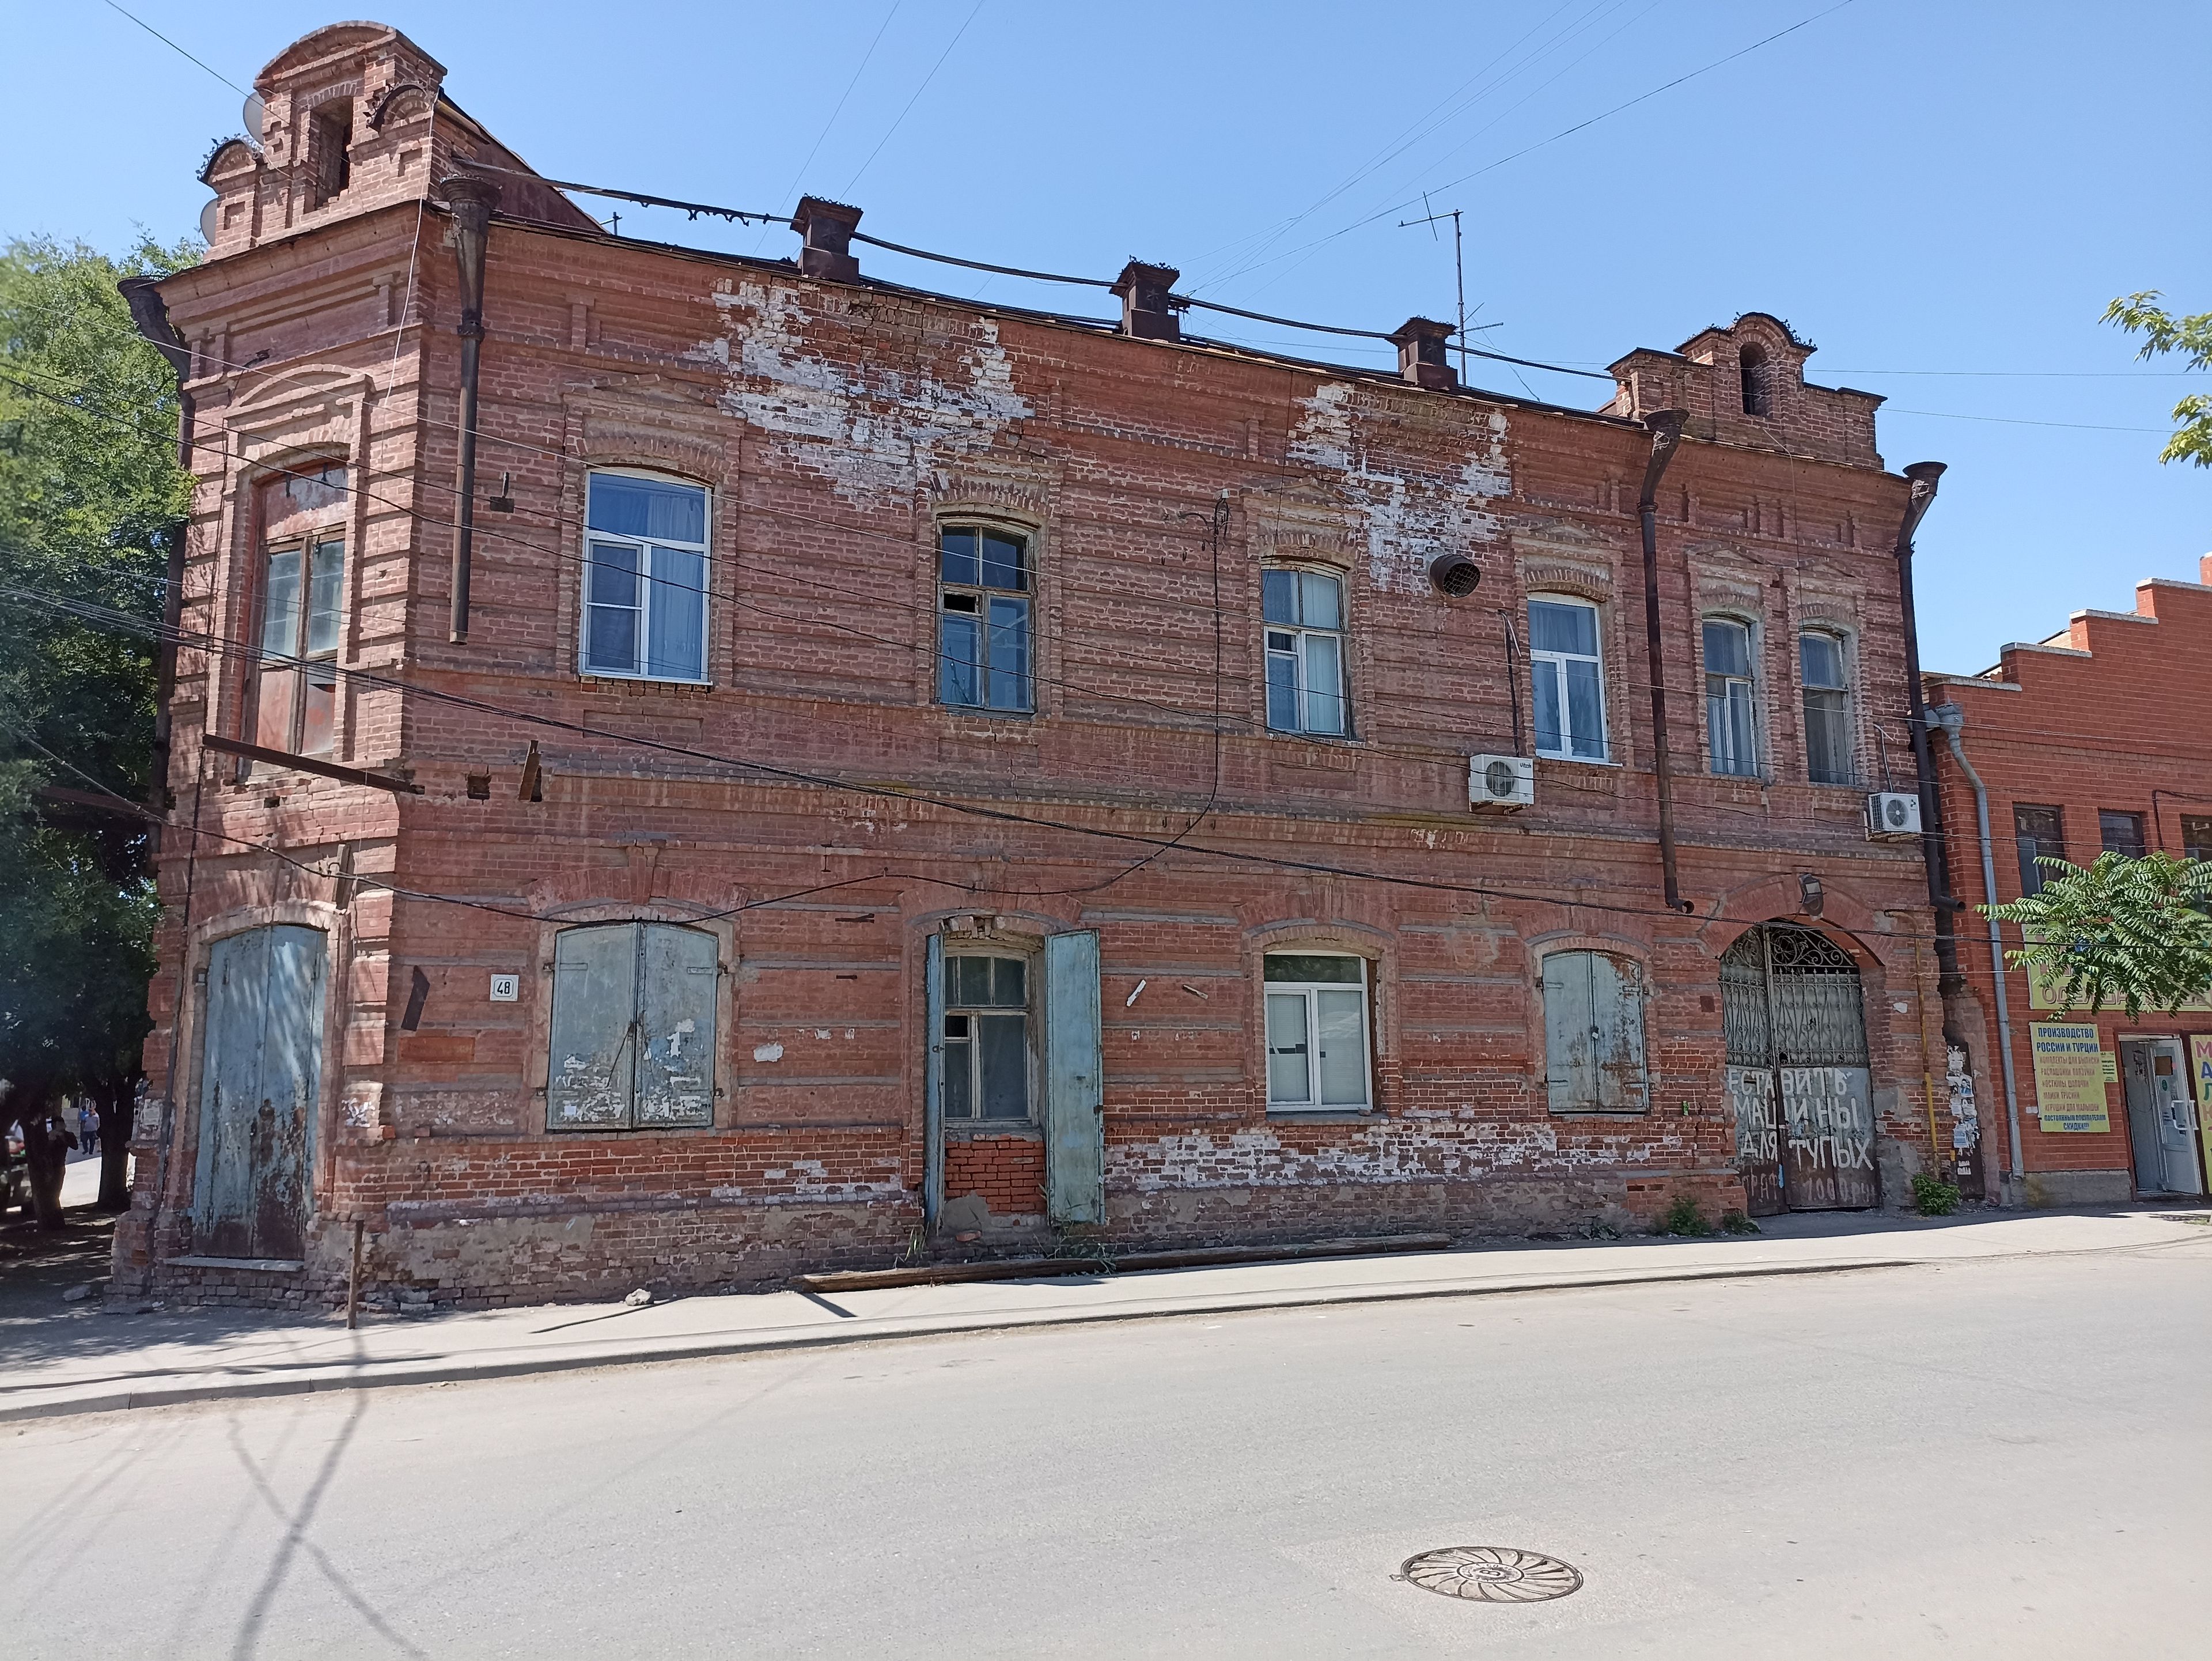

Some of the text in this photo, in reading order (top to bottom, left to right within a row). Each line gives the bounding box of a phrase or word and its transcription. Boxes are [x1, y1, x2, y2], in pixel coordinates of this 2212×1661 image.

[497, 981, 510, 994] 48
[2038, 1027, 2094, 1039] ПРОИЗВОДСТВО
[2036, 1042, 2065, 1053] РОССИИ
[2066, 1042, 2071, 1052] И
[2073, 1042, 2099, 1054] ТУРЦИИ
[2040, 1056, 2068, 1064] КОМПЛЕКТЫ
[2041, 1068, 2096, 1076] РАСПАШОНКИ ПОЛЗУНКИ
[2042, 1080, 2089, 1088] КОСТЮМЫ ШАПОЧКИ
[1733, 1095, 1859, 1132] МАШИНЫ
[2045, 1103, 2066, 1112] ИГРУШКИ
[2066, 1103, 2075, 1112] ДЛЯ
[1740, 1131, 1874, 1173] ДЛЯ ТУПЫХ
